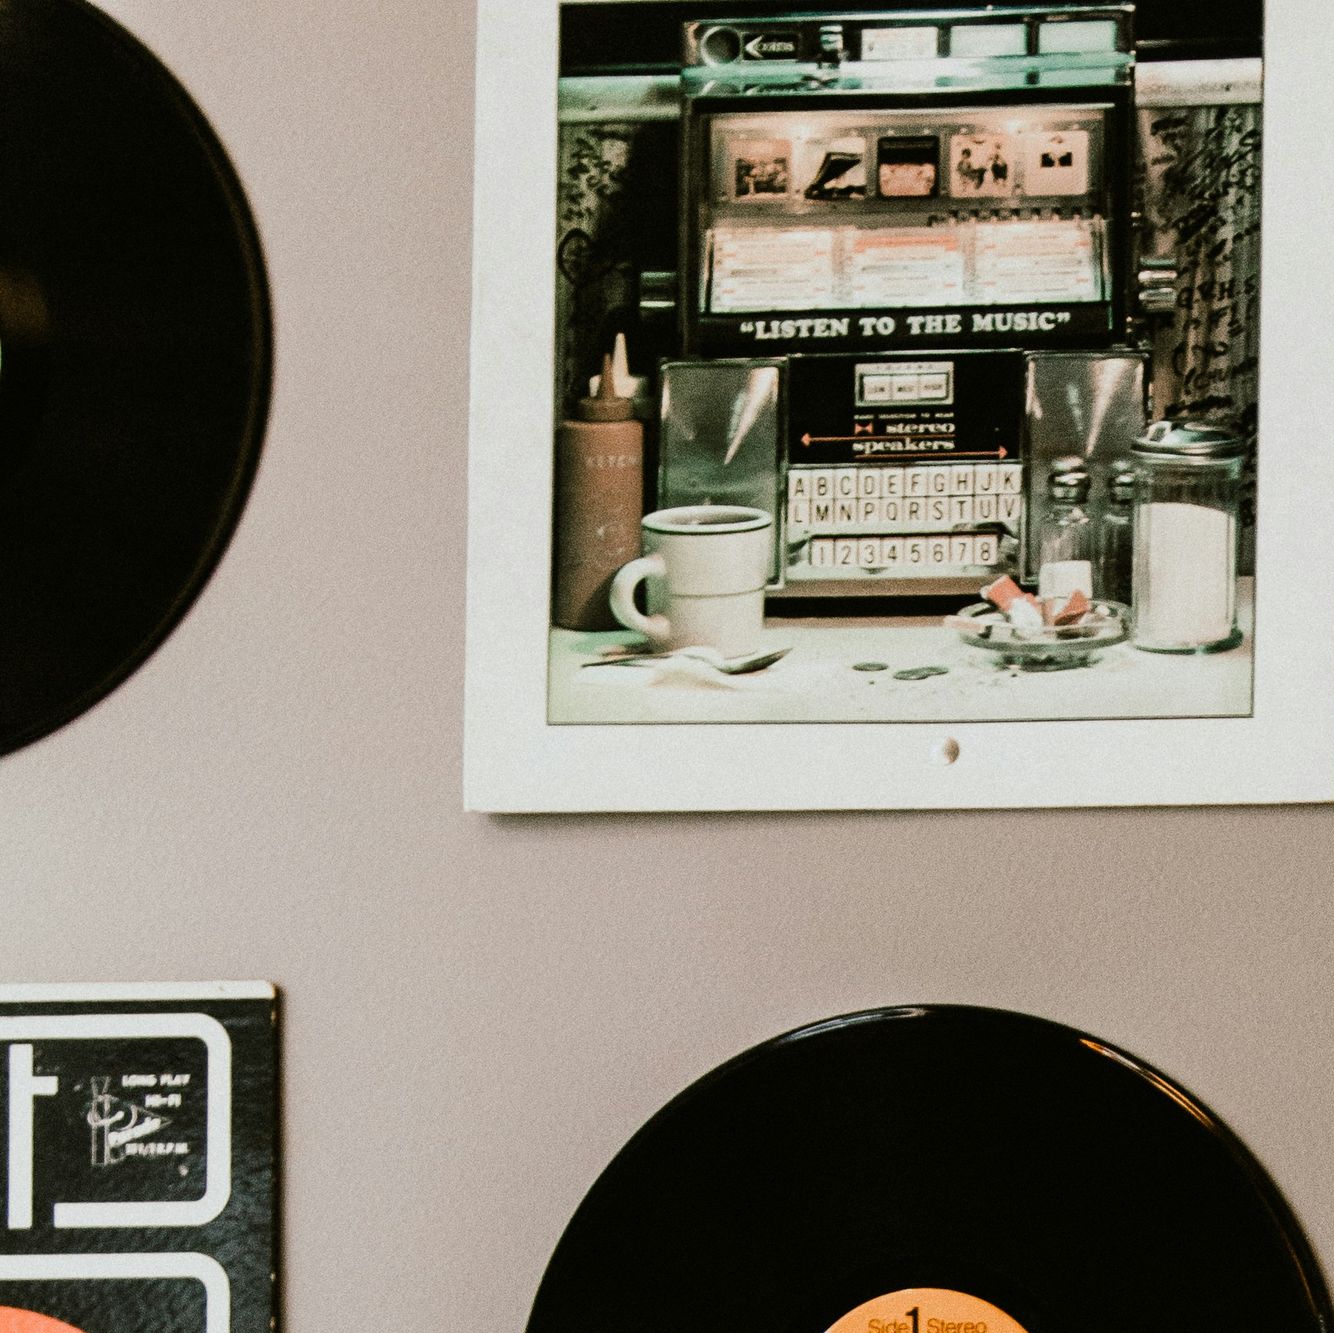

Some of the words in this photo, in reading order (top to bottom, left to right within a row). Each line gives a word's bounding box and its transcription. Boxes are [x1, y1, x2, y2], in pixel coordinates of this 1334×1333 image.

[858, 316, 896, 336] TO
[906, 314, 963, 335] THE
[886, 422, 956, 434] stereo
[852, 437, 956, 454] speakers
[794, 477, 804, 496] A
[817, 476, 827, 496] B
[840, 476, 851, 496] C
[863, 475, 874, 495] D
[887, 475, 897, 495] E
[910, 473, 921, 493] F
[933, 473, 945, 493] G
[956, 472, 968, 491] H
[982, 472, 991, 491] J
[1003, 471, 1014, 490] K
[794, 503, 803, 524] L
[816, 504, 829, 521] M
[840, 504, 852, 521] N
[863, 502, 874, 522] P
[886, 501, 898, 521] Q
[909, 501, 920, 520] R
[933, 501, 944, 521] S
[956, 500, 967, 520] T
[980, 499, 991, 519] U
[1004, 497, 1016, 518] V
[819, 546, 825, 564] 1
[841, 545, 851, 565] 2
[864, 545, 875, 565] 3
[887, 545, 897, 561] 4
[910, 544, 921, 563] 5
[933, 543, 944, 562] 6
[958, 542, 967, 561] 7
[980, 541, 990, 561] 8
